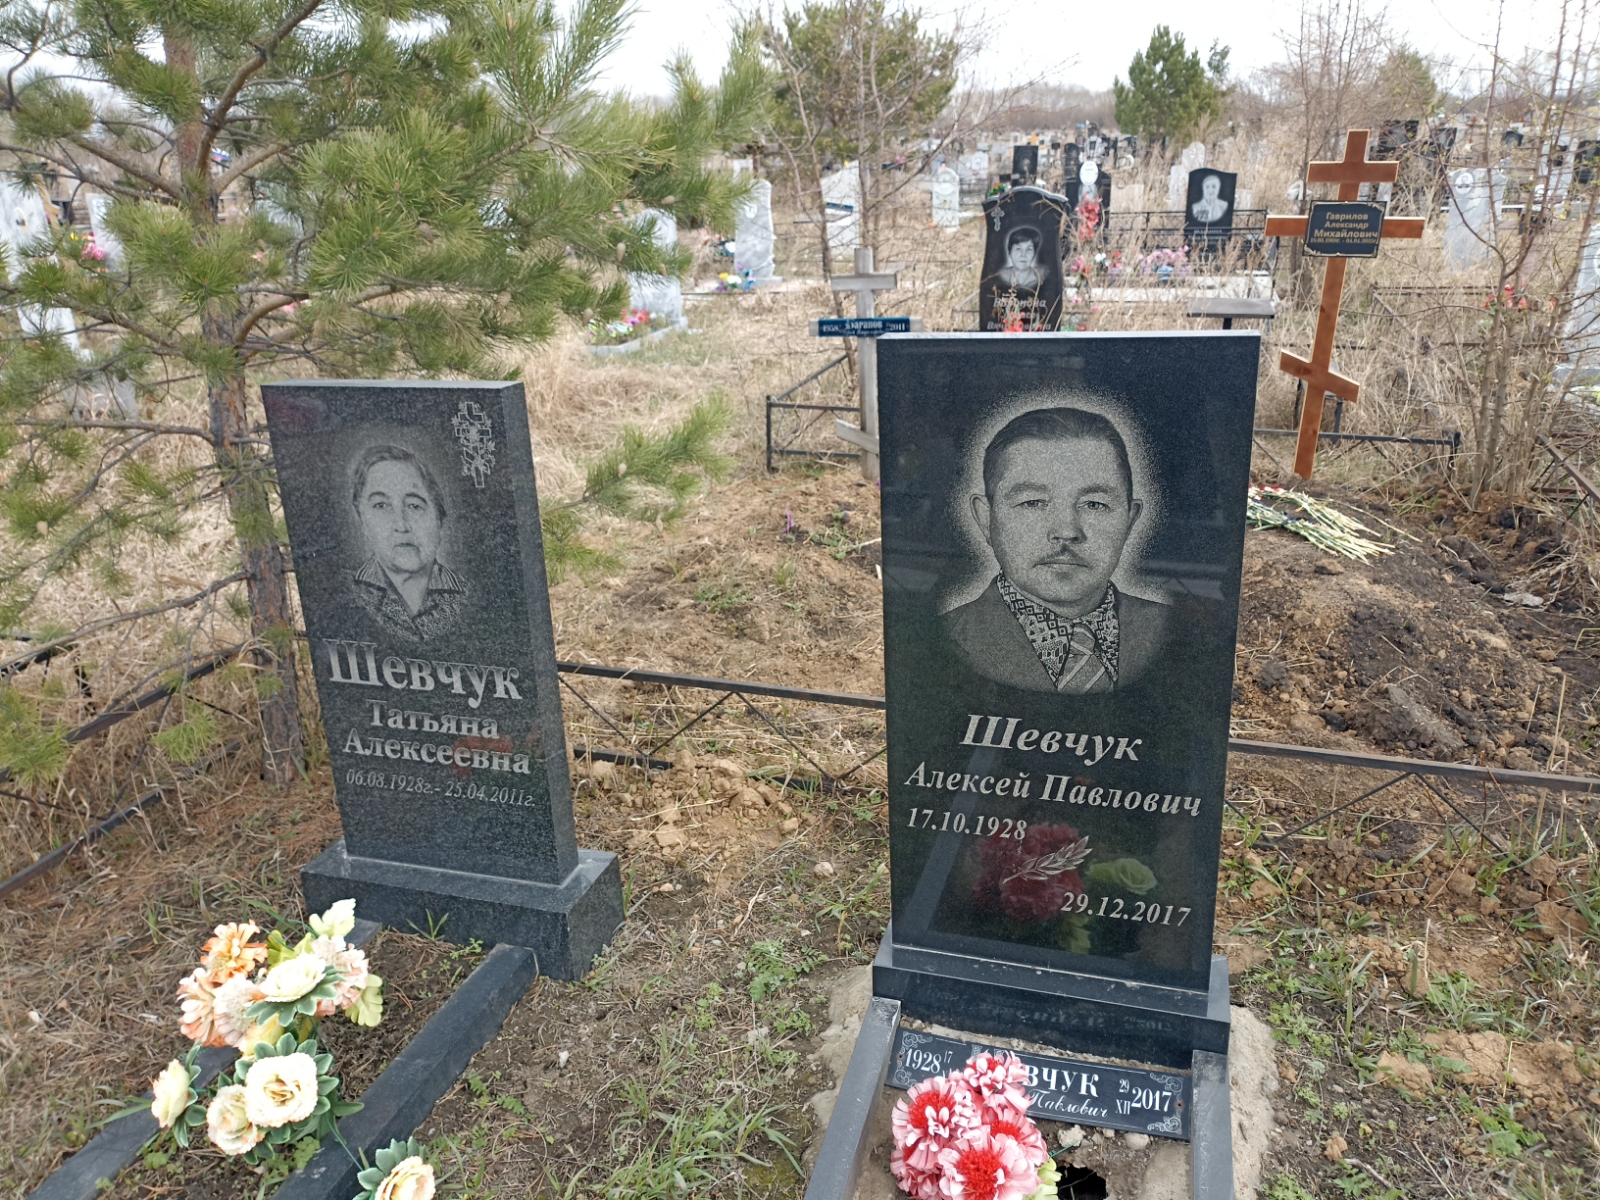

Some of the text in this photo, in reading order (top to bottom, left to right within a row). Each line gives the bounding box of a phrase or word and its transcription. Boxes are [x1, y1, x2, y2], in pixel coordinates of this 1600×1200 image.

[1324, 221, 1369, 229] Александр
[1326, 212, 1369, 222] Гаврилов
[1314, 229, 1378, 238] Михайлович
[322, 638, 523, 709] Шевчук
[365, 699, 500, 740] Татьяна
[342, 728, 531, 775] Алексеевна
[959, 714, 1142, 767] Шевчук
[904, 761, 1202, 817] Алексей Павлович
[906, 808, 1028, 840] 17.10.1928
[1060, 892, 1192, 927] 29.12.2017
[904, 1048, 954, 1074] 1928 17
[1119, 1078, 1130, 1094] 29
[1131, 1086, 1173, 1113] 2017
